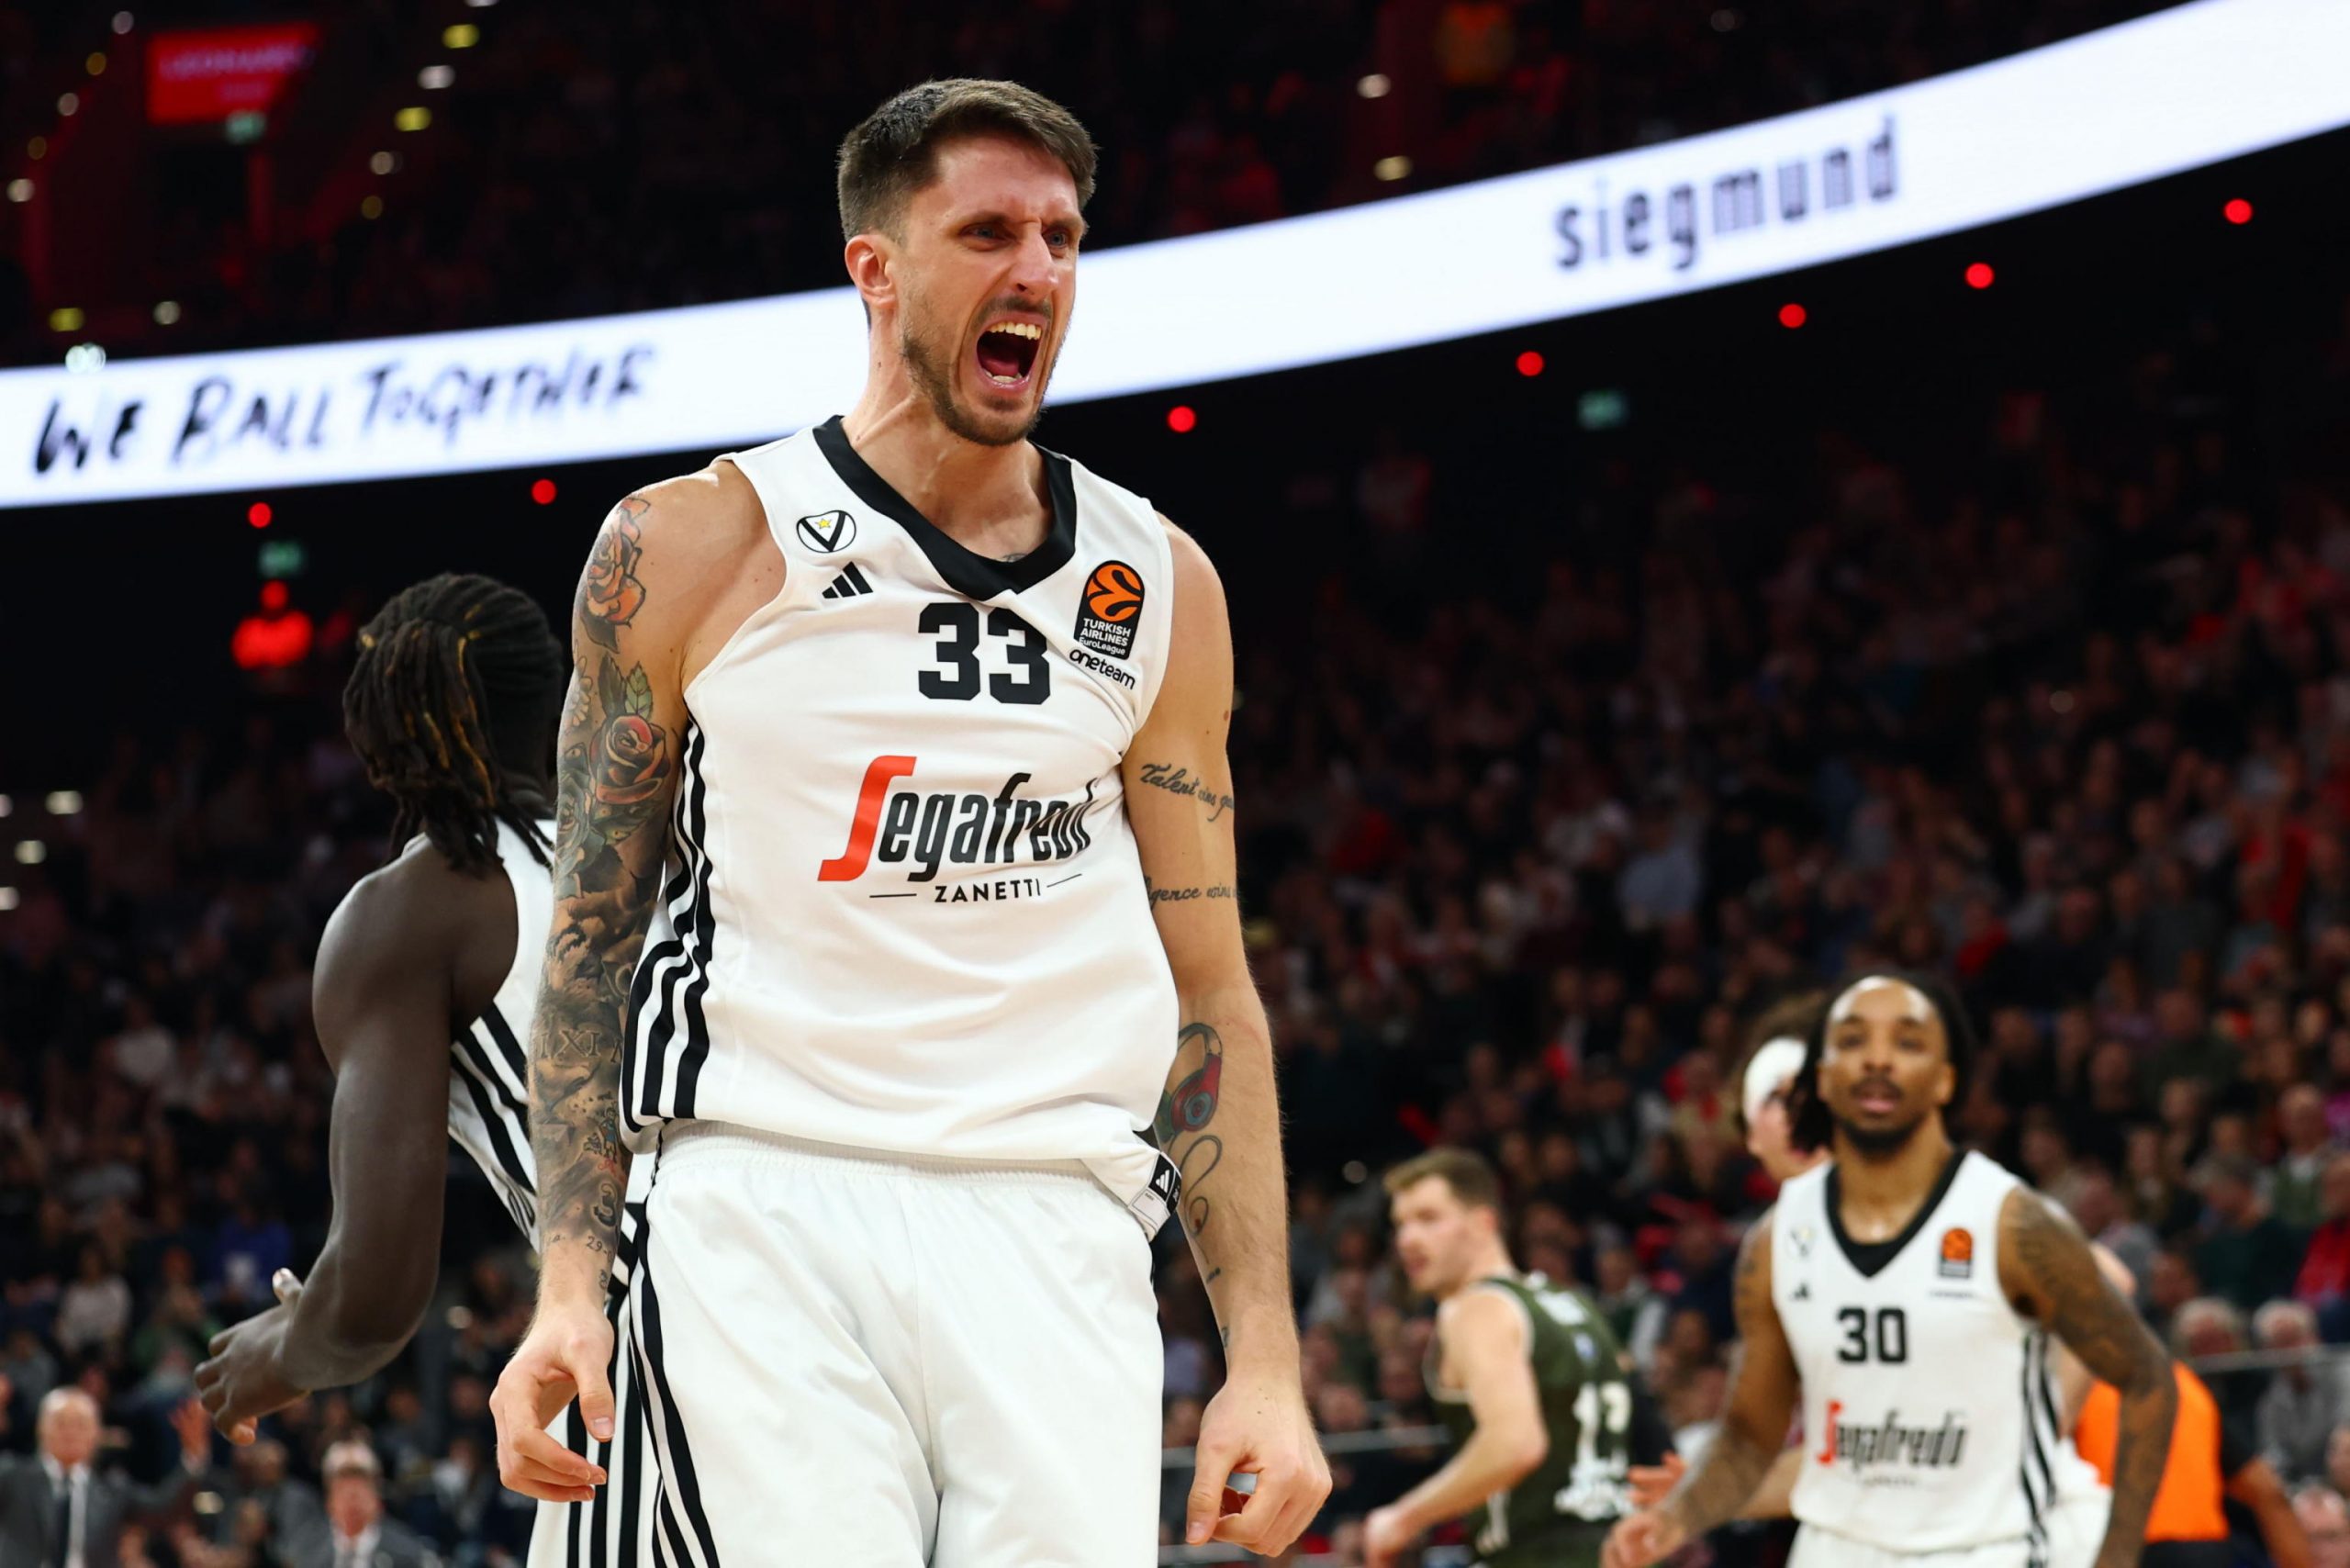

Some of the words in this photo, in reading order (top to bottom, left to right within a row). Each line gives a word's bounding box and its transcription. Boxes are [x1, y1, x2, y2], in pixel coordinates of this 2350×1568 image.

[1556, 114, 1897, 270] siegmund
[31, 398, 144, 476] WE
[173, 373, 332, 467] BALL
[1080, 628, 1128, 646] AIRLINES
[1083, 618, 1131, 637] TURKISH
[918, 602, 1050, 705] 33
[1079, 637, 1125, 655] EuroLeague
[1069, 649, 1136, 689] oneteam
[1140, 764, 1200, 795] Talent
[934, 879, 1041, 902] ZANETTI
[1838, 1307, 1907, 1362] 30
